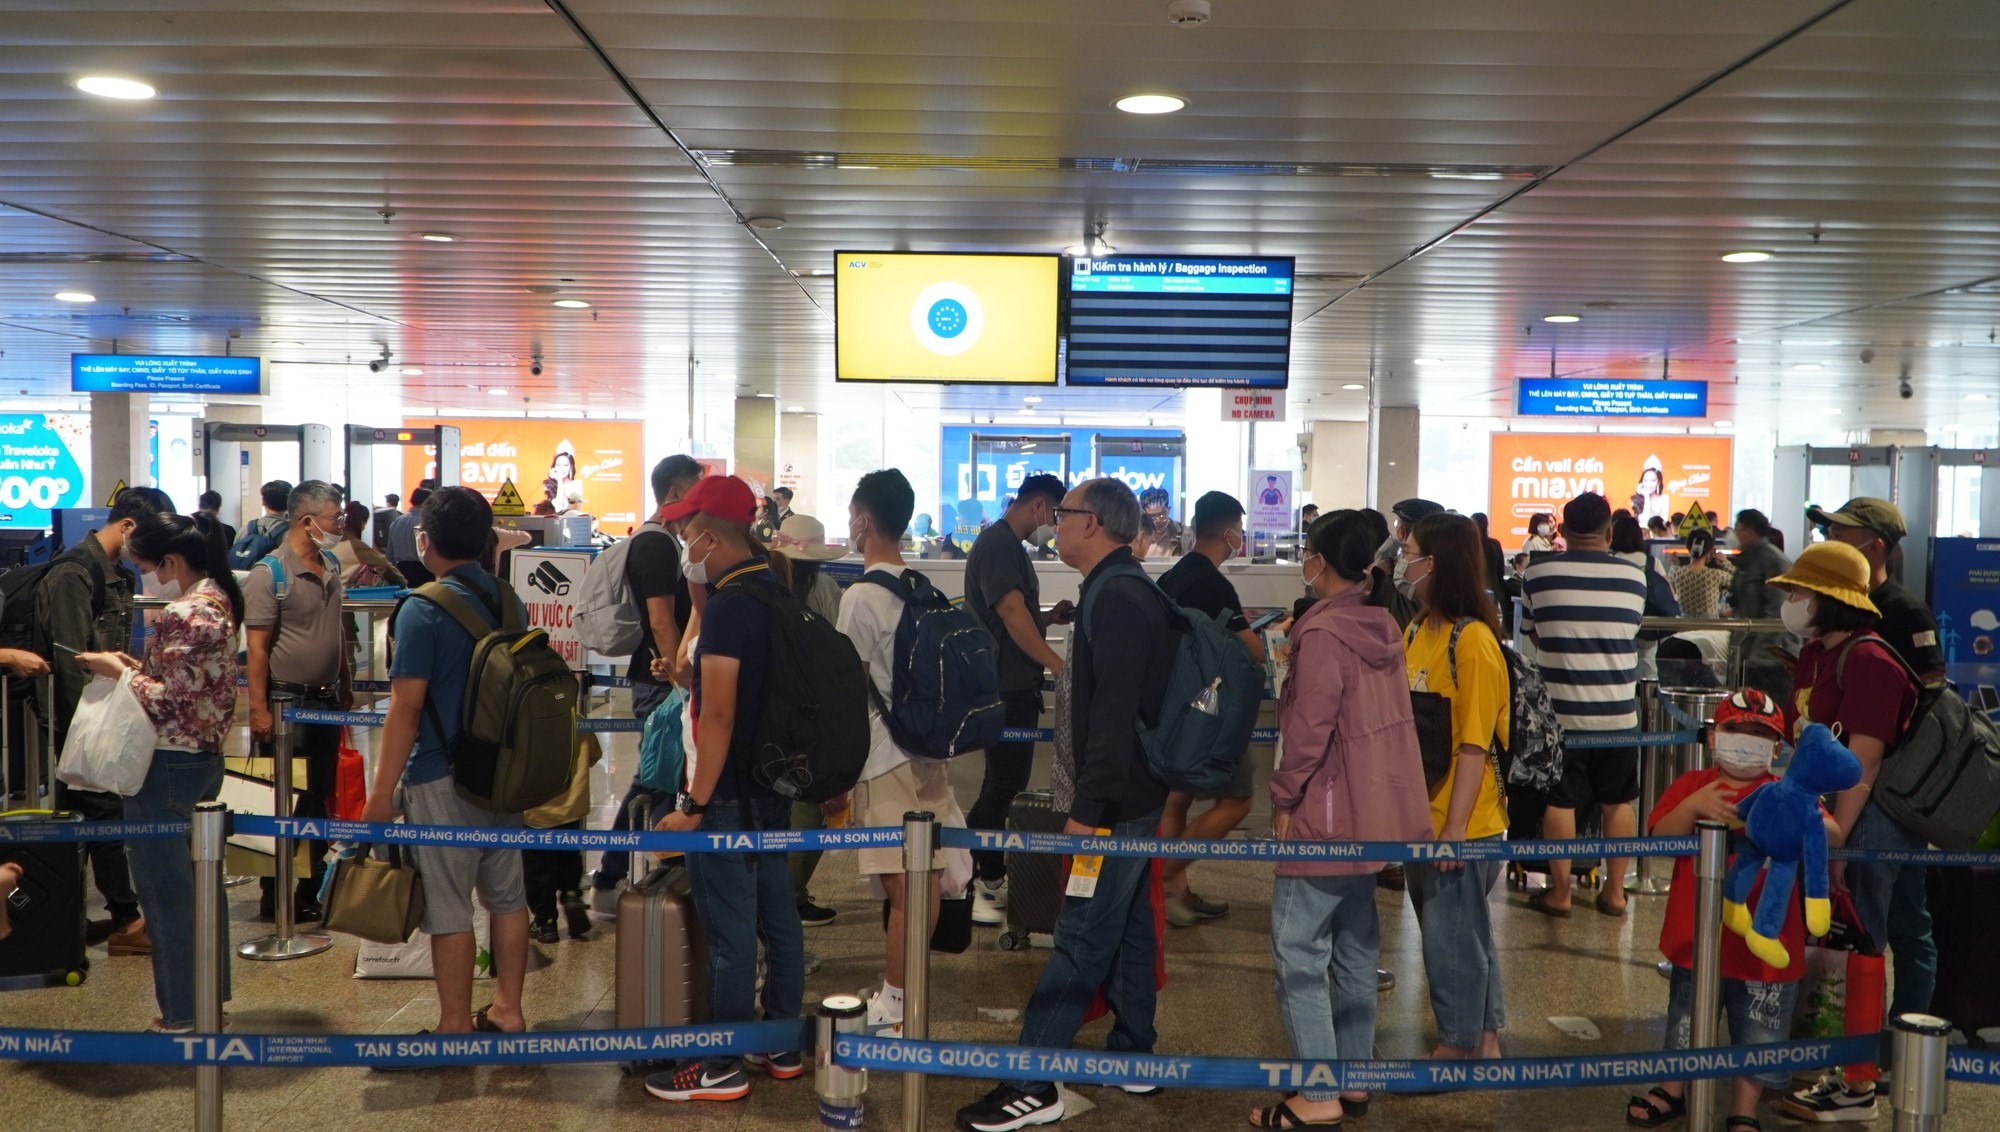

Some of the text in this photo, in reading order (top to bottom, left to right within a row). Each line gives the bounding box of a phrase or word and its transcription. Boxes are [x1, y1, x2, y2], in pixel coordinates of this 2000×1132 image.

[1092, 261, 1116, 272] Kiểm
[1118, 263, 1132, 272] tra
[1133, 262, 1156, 273] hành
[1159, 262, 1167, 274] lý
[1168, 263, 1174, 273] /
[1176, 263, 1216, 276] Baggage
[1234, 394, 1272, 406] CHỤP HÌNH
[1232, 410, 1275, 418] NO CAMERA
[374, 430, 385, 440] 4A
[2, 445, 60, 456] Traveloka
[486, 441, 516, 457] đến
[1849, 452, 1859, 460] 7A
[0, 458, 19, 470] uân
[20, 458, 46, 470] Như
[1546, 457, 1571, 472] vali
[1574, 456, 1604, 473] đến
[0, 475, 60, 510] 00
[542, 599, 563, 632] VỰC
[565, 634, 578, 662] SÁT
[296, 710, 320, 720] CẢNG
[322, 712, 345, 722] HÀNG
[347, 714, 376, 724] KHÔNG
[1022, 730, 1043, 739] NHẤT
[1578, 736, 1640, 745] INTERNATIONAL
[1642, 734, 1676, 742] AIRPORT
[72, 826, 94, 836] TAN
[98, 826, 124, 836] SON
[126, 824, 156, 835] NHAT
[274, 820, 320, 836] TIA
[384, 825, 640, 845] CẢNG HÀNG KHÔNG QUỐC TẾ TÂN SƠN NHẤT
[708, 834, 753, 849] TIA
[818, 832, 903, 844] TAN SON NHAT
[975, 832, 1024, 848] TIA
[1081, 836, 1364, 856] CẢNG HÀNG KHÔNG QUỐC TẾ TÂN SƠN NHẤT
[1407, 844, 1456, 858] TIA
[1511, 840, 1700, 855] TAN SON NHAT INTERNATIONAL
[1911, 851, 1943, 862] HÀNG
[1946, 852, 1986, 862] KHÔNG
[0, 1033, 72, 1054] ƠN NHẤT
[173, 1037, 254, 1061] TIA
[354, 1032, 734, 1057] TAN SON NHAT INTERNATIONAL AIRPORT
[857, 1040, 1192, 1080] KHÔNG QUỐC TẾ TÂN SƠN NHẤT
[1429, 1045, 1832, 1083] TAN SON NHAT INTERNATIONAL AIRPORT
[1260, 1064, 1338, 1087] TIA
[1347, 1071, 1416, 1080] INTERNATIONAL
[1348, 1082, 1386, 1090] AIRPORT
